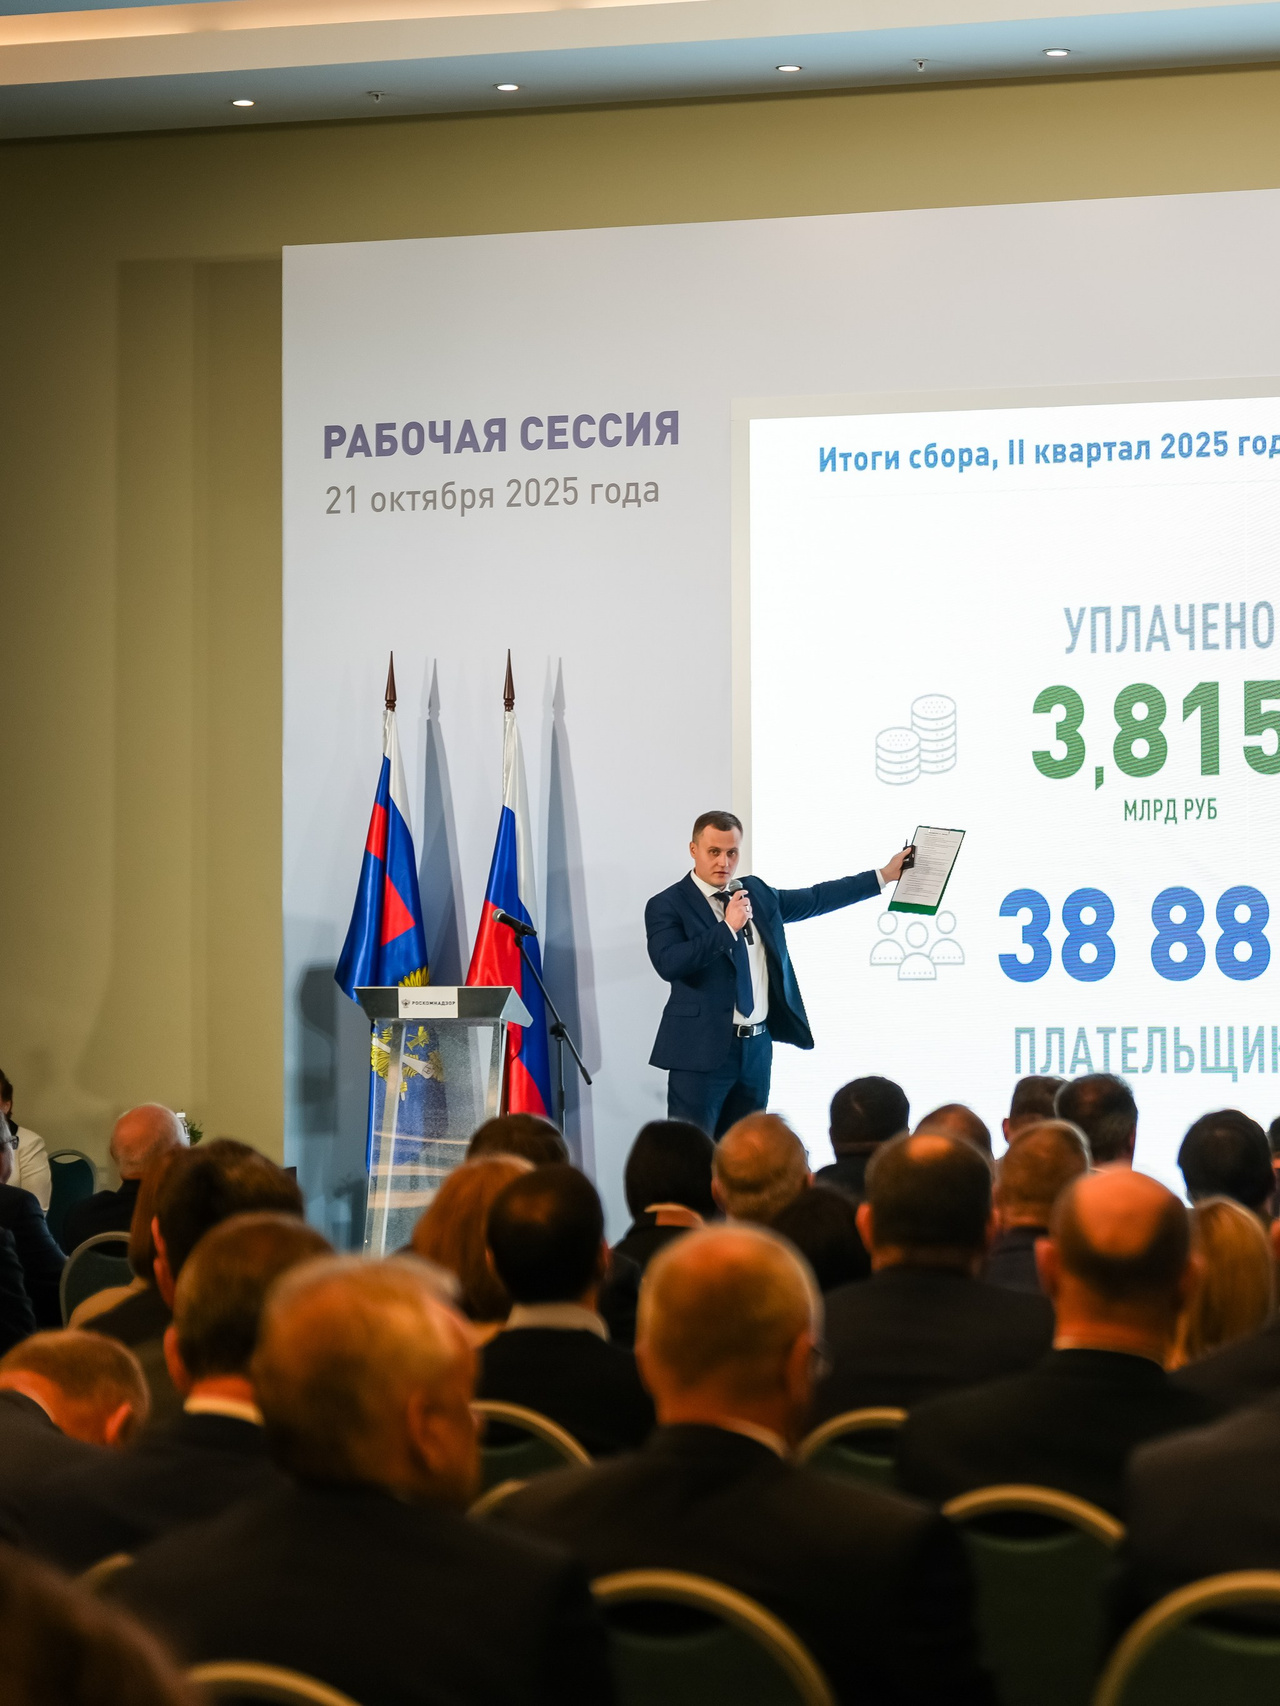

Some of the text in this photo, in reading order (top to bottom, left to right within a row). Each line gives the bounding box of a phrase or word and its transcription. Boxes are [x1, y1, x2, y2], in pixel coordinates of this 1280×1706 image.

[323, 410, 680, 459] РАБОЧАЯ СЕССИЯ
[819, 446, 900, 472] Итоги
[908, 443, 999, 472] сбора,
[1035, 438, 1151, 469] квартал
[1160, 430, 1229, 459] 2025
[325, 477, 660, 517] 21 октября 2025 года
[1063, 600, 1276, 655] УПЛАЧЕНО
[1124, 797, 1218, 825] МЛРД РУБ
[998, 887, 1116, 983] 38
